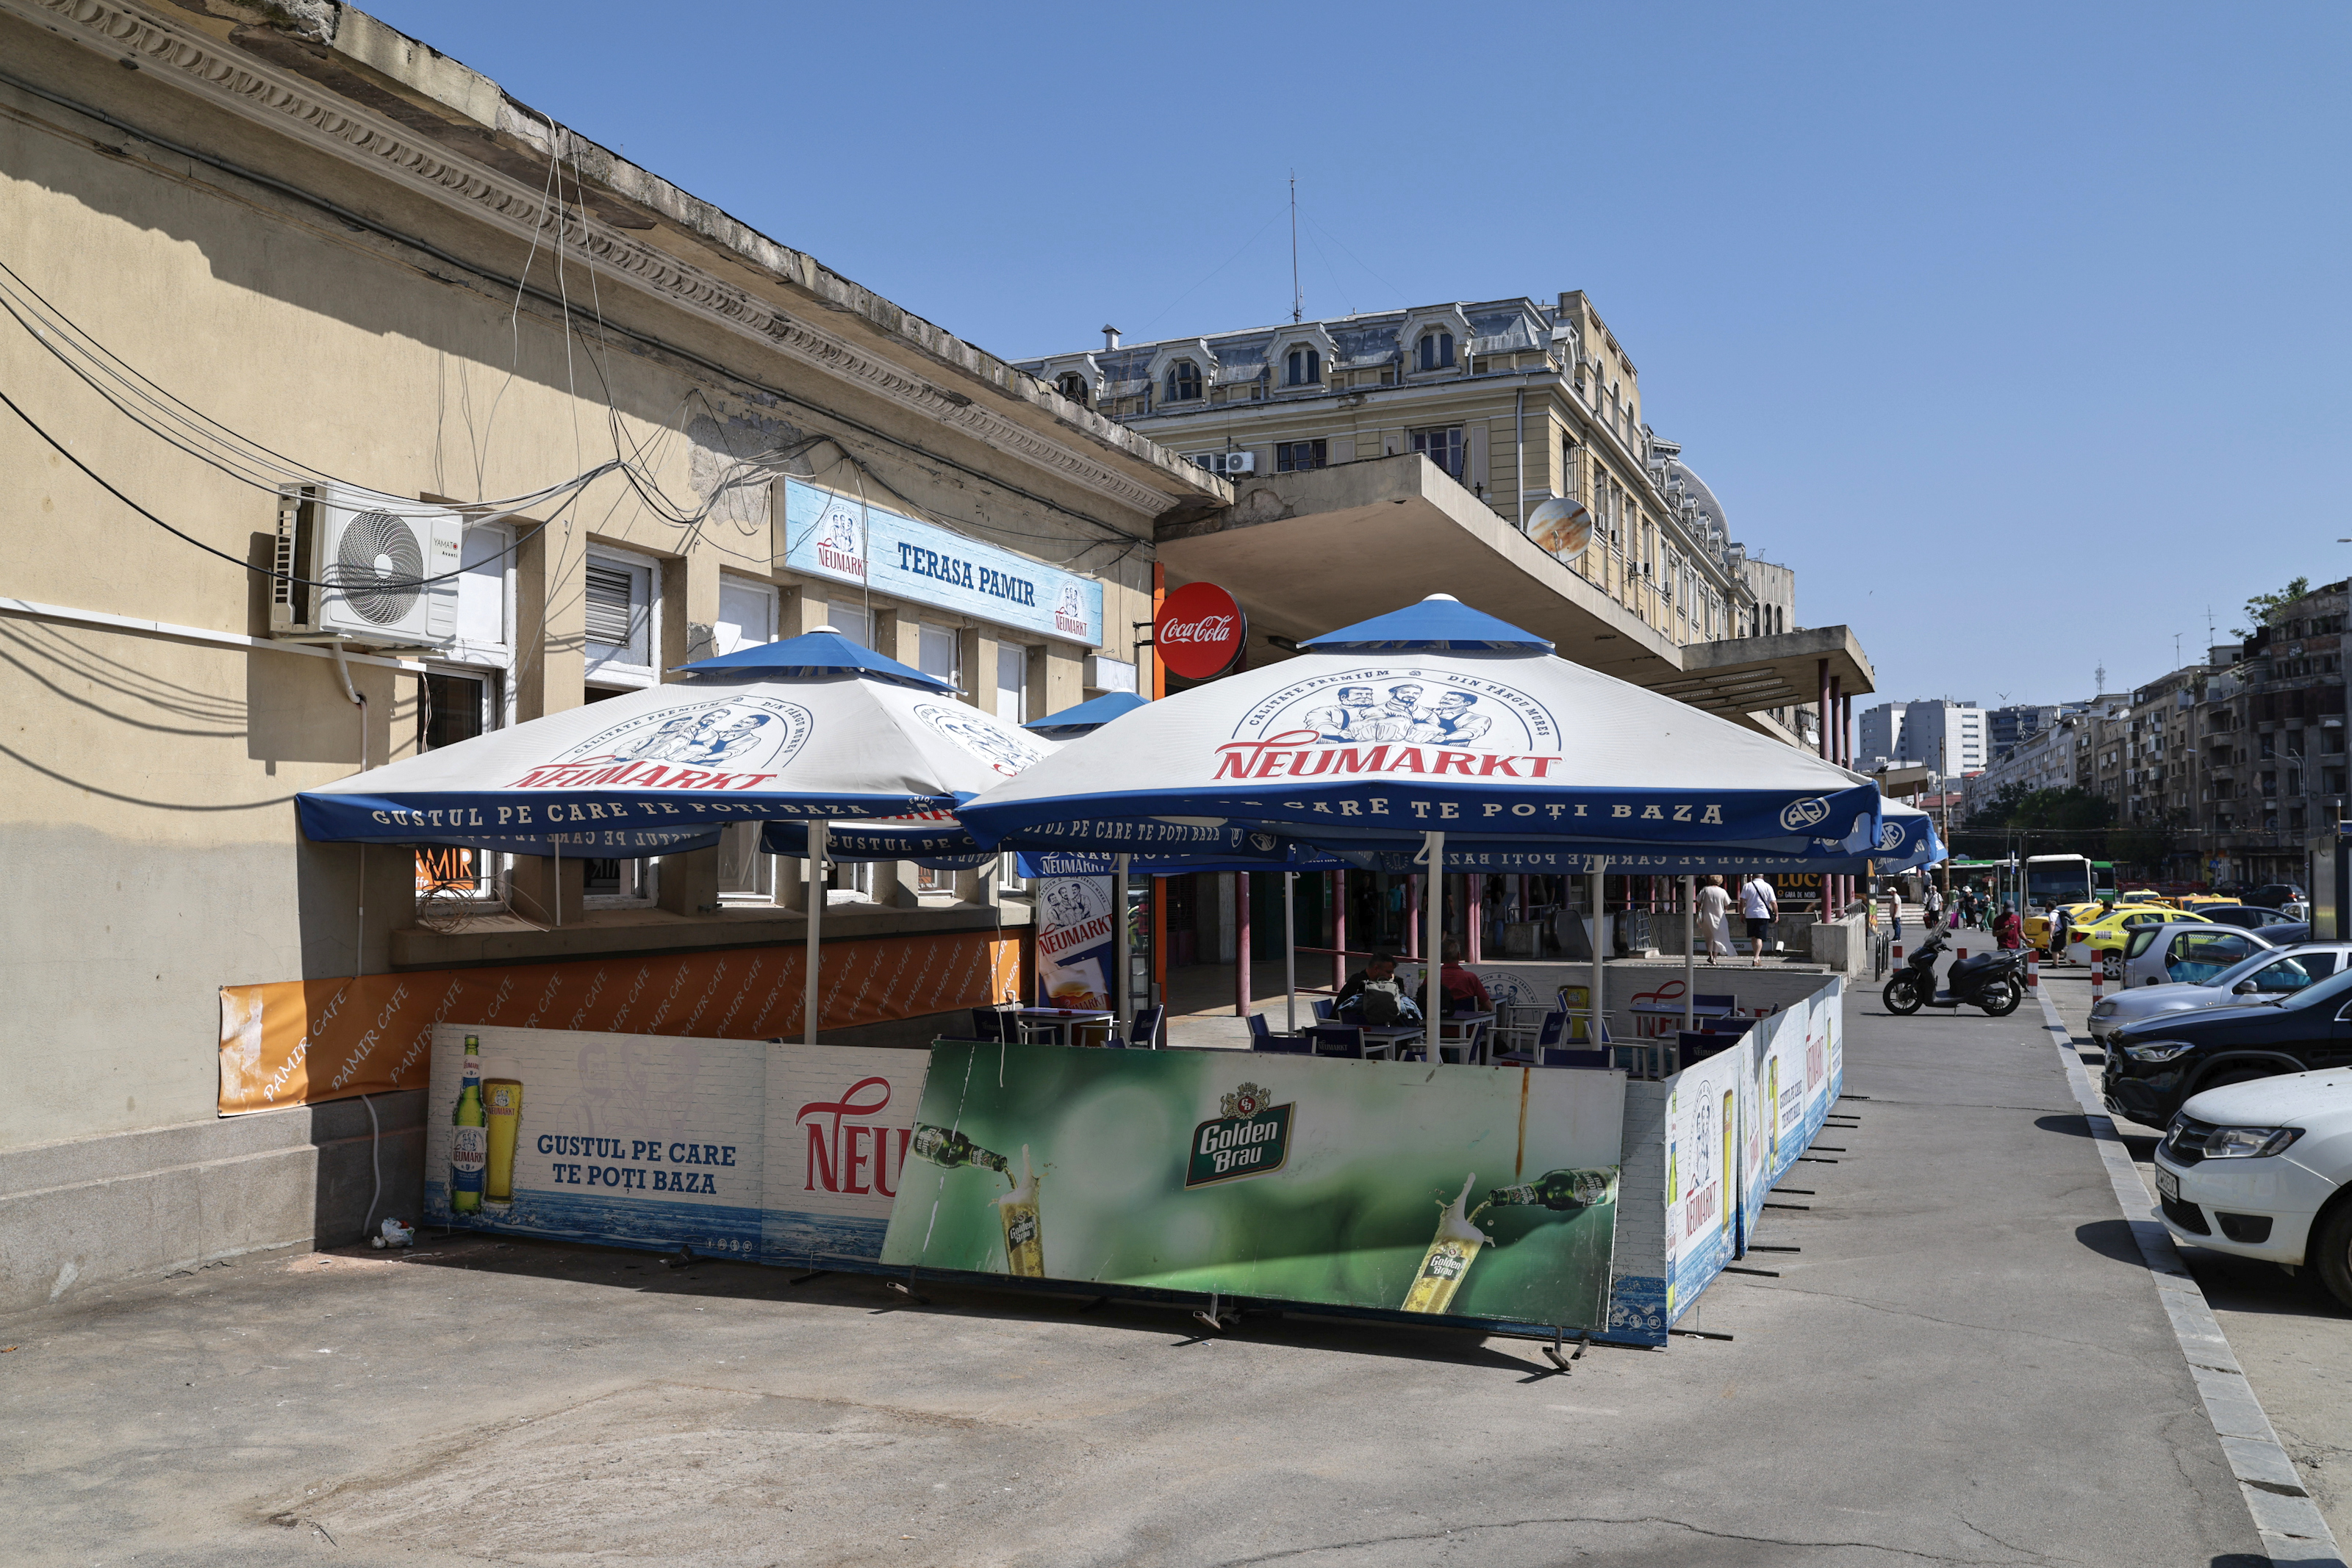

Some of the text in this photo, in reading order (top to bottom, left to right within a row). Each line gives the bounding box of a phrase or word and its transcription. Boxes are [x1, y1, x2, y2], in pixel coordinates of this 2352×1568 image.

[434, 538, 458, 550] YAMATO
[898, 542, 974, 589] TERASA
[979, 567, 1036, 607] PAMIR
[1055, 607, 1087, 636] NEUMARKT
[1160, 615, 1235, 644] Coca-Cola
[1249, 687, 1304, 726] CALITATE
[1308, 669, 1390, 687] PREMIUM
[1448, 675, 1481, 686] DIN
[574, 719, 639, 754] CALITATE
[647, 701, 720, 721] PREMIUM
[760, 701, 784, 711] DIN
[504, 755, 780, 790] NEUMARKT
[1210, 730, 1563, 780] NEUMARKT
[372, 808, 483, 827] GUSTUL
[498, 805, 532, 824] PE
[547, 802, 628, 822] CARE
[637, 802, 680, 815] TE
[780, 804, 870, 815] BAZA
[908, 796, 934, 805] ENJOY
[1283, 798, 1389, 816] CARE
[1410, 801, 1459, 819] TE
[1612, 804, 1724, 824] BAZA
[825, 835, 912, 852] GUSTUL
[922, 838, 952, 850] PE
[1069, 820, 1090, 837] PE
[1096, 821, 1132, 840] CARE
[1138, 824, 1155, 841] TE
[1192, 827, 1221, 841] BAZA
[585, 967, 608, 1008] CAFE
[669, 961, 690, 999] CAFE
[708, 957, 728, 996] CAFE
[818, 947, 858, 1025] PAMIR CAFE
[847, 946, 886, 1020] PAMIR CAFE
[876, 943, 913, 1016] PAMIR CAFE
[903, 941, 939, 1013] PAMIR CAFE
[929, 939, 963, 1009] PAMIR CAFE
[956, 938, 986, 1005] PAMIR CAFE
[488, 974, 514, 1018] CAFE
[539, 971, 563, 1013] CAFE
[608, 964, 650, 1033] MIR CAFE
[716, 955, 764, 1038] PAMIR CAFE
[752, 953, 796, 1034] PAMIR CAFE
[263, 987, 347, 1101] PAMIR CAFE
[331, 982, 409, 1091] PAMIR CAFE
[390, 978, 464, 1083] PAMIR CAFE
[1318, 1040, 1348, 1051] NEUMARKT
[487, 1103, 515, 1116] NEUMARKT
[537, 1134, 736, 1167] GUSTUL PE CARE
[1200, 1121, 1278, 1155] Golden
[1213, 1146, 1262, 1173] Brau
[553, 1163, 717, 1195] TE POȚI BAZA
[1593, 1176, 1604, 1192] rau
[1685, 1173, 1716, 1240] NEUMARKT
[1010, 1221, 1033, 1239] Golden
[1015, 1230, 1030, 1243] Brau
[1430, 1255, 1461, 1270] Golden
[1433, 1266, 1453, 1276] Brau
